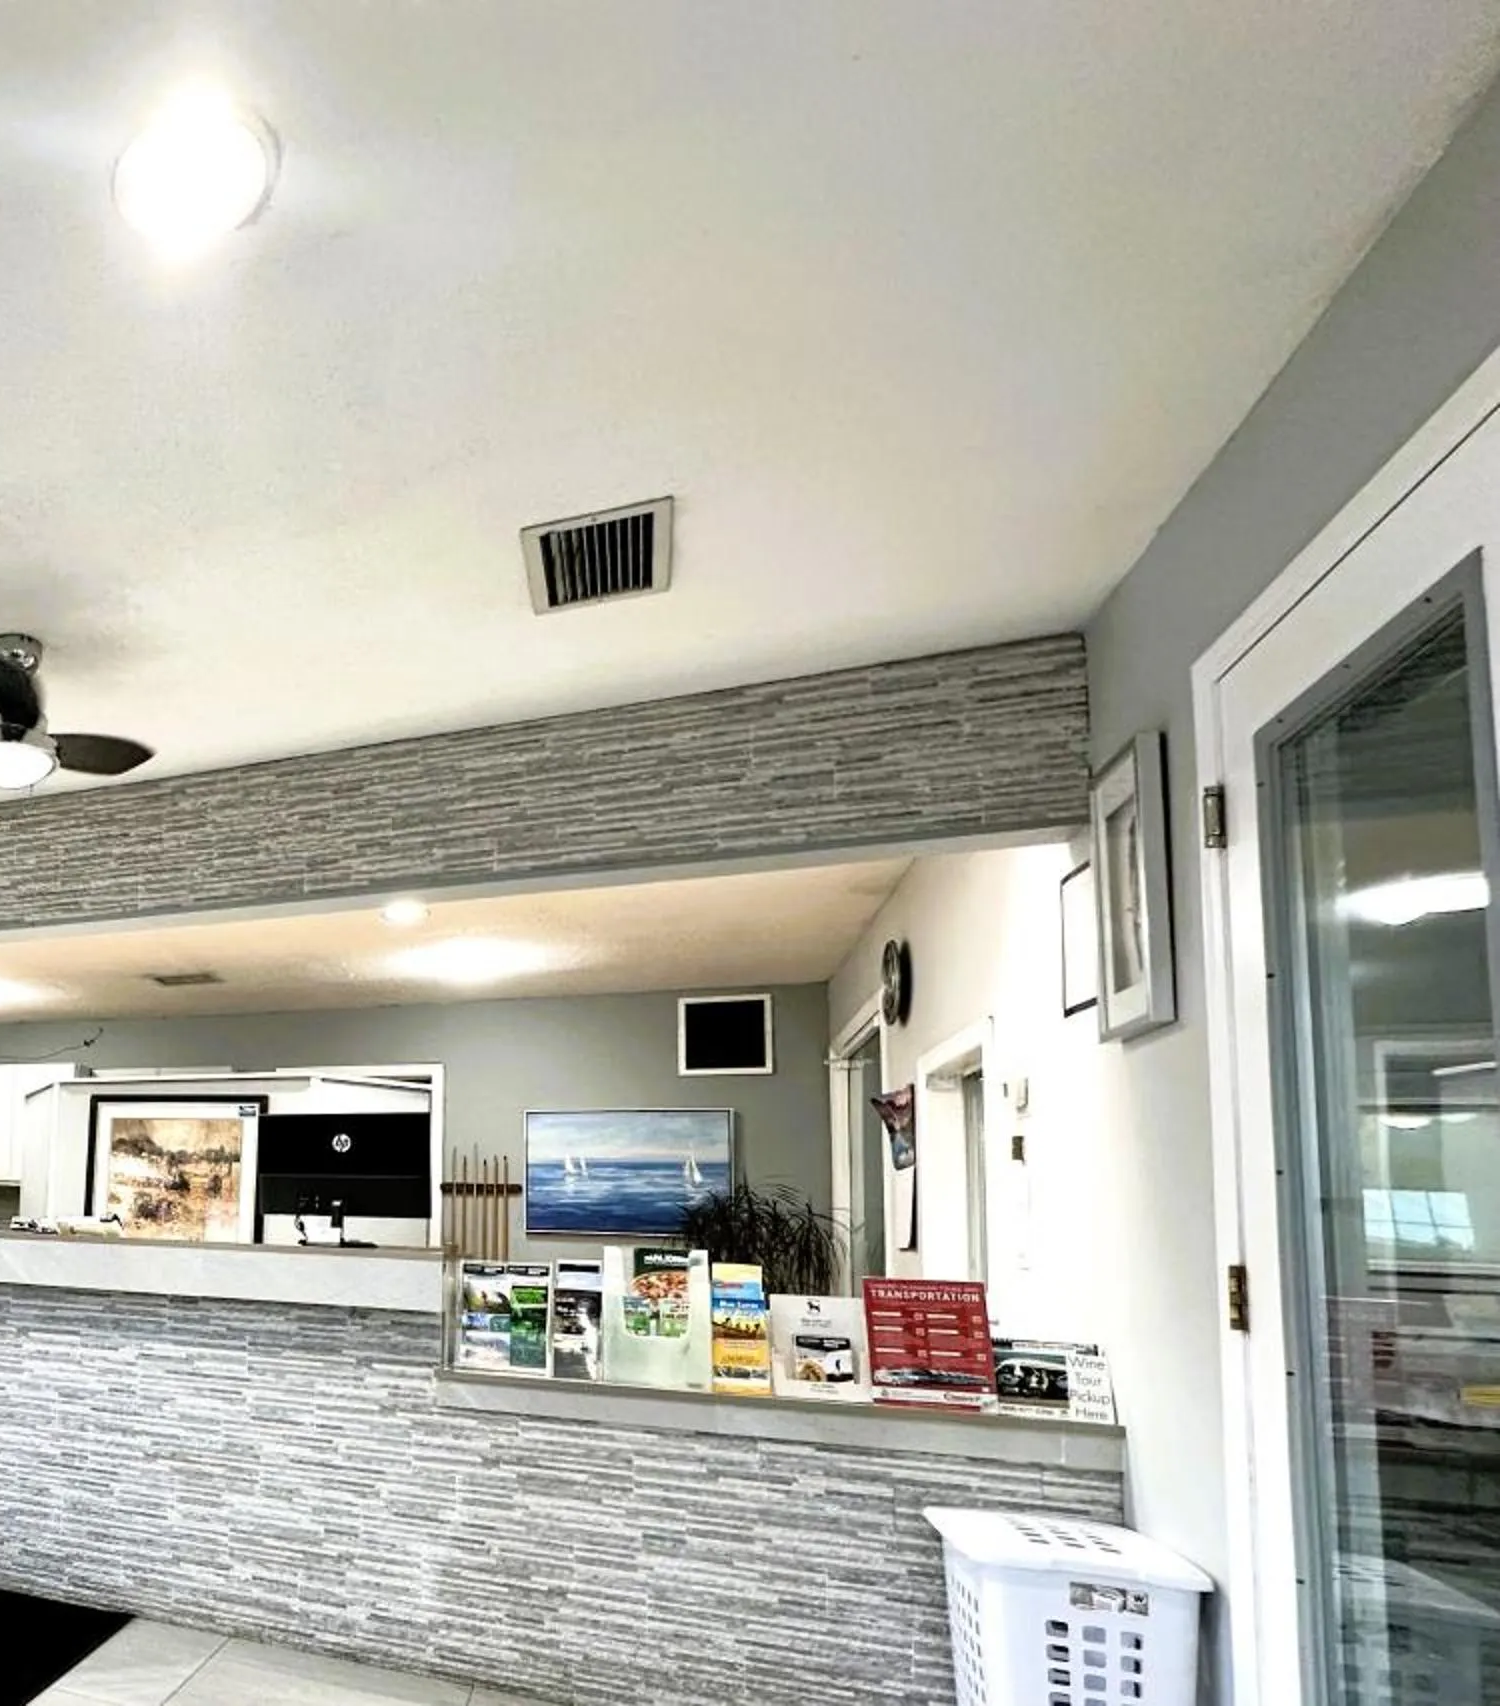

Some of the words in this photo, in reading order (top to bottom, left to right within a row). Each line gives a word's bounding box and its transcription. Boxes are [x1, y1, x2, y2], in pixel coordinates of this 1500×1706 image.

[332, 1134, 351, 1152] hp
[870, 1290, 980, 1302] TRANSPORTATION
[1068, 1355, 1105, 1370] Wine
[1075, 1371, 1101, 1386] Tour
[1069, 1389, 1111, 1406] Pickup
[1075, 1407, 1109, 1420] Here
